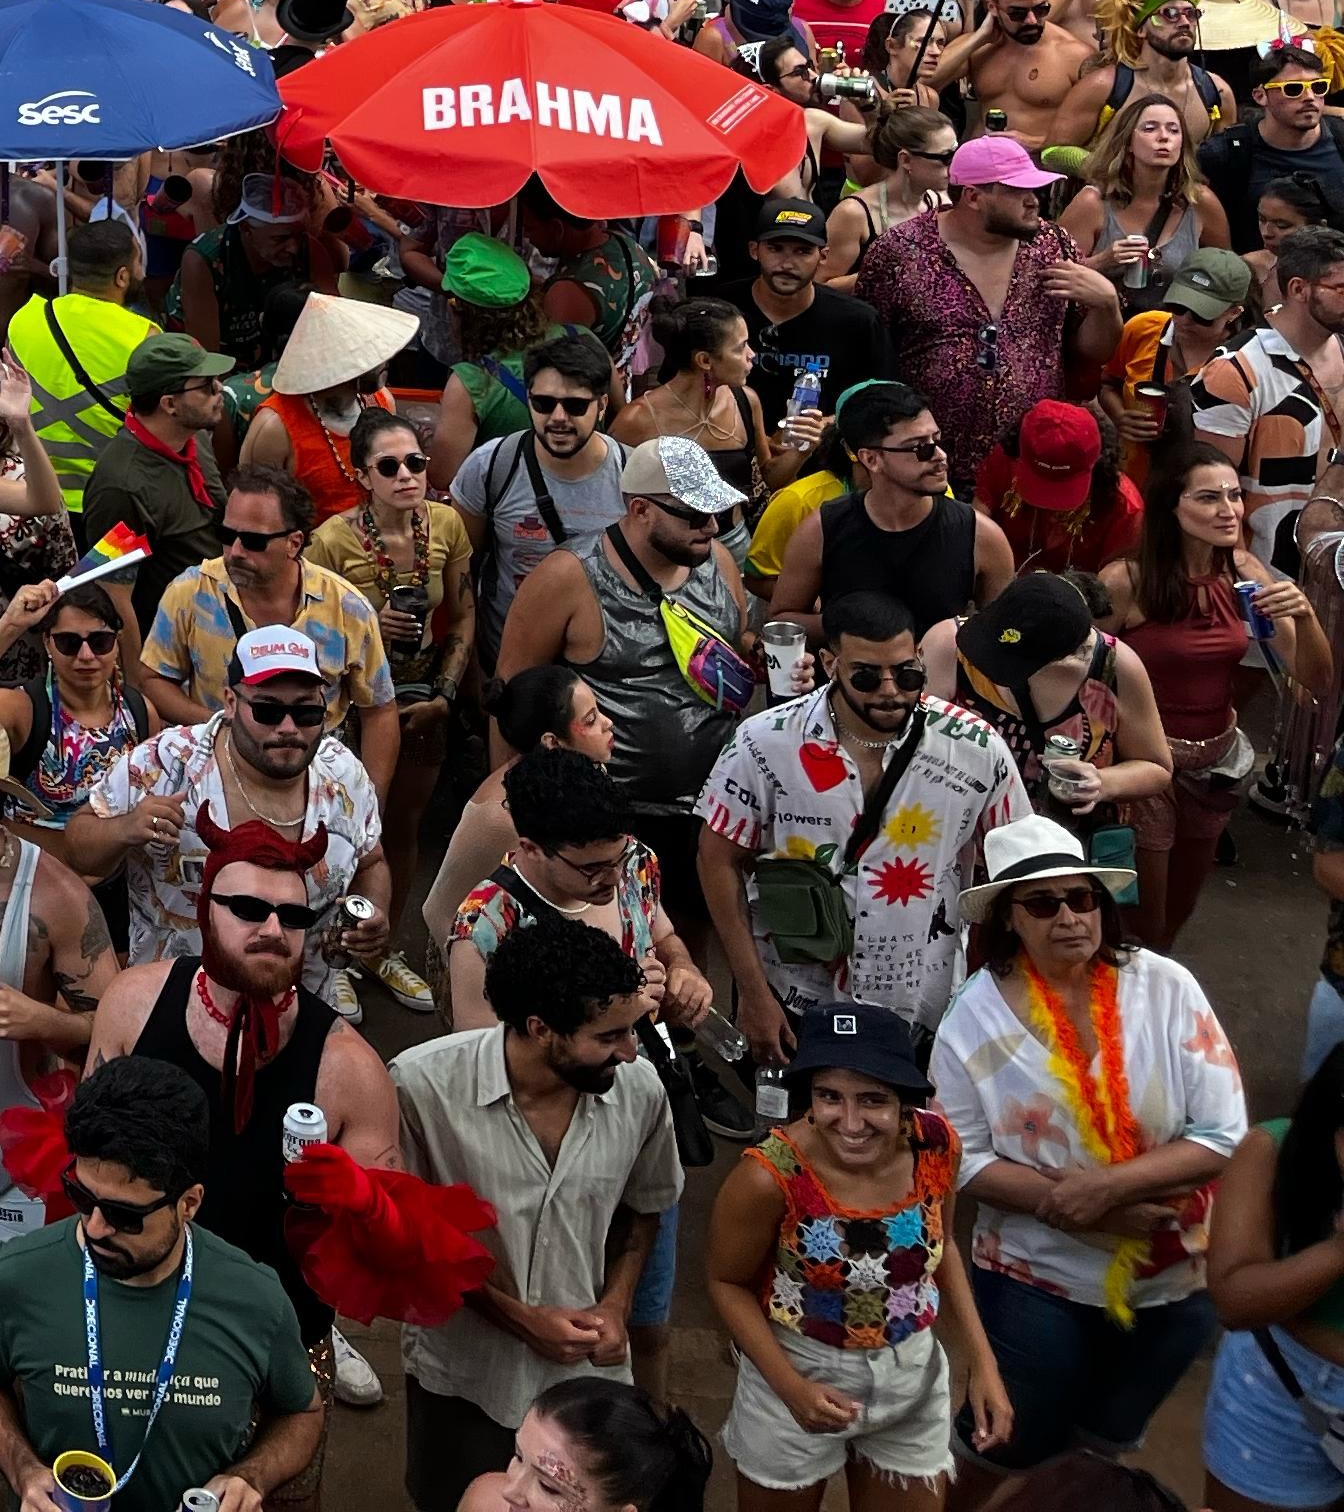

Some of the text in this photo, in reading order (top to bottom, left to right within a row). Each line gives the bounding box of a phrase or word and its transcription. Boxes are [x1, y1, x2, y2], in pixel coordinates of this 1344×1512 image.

[423, 78, 662, 146] BRAHMA
[113, 1370, 122, 1381] a
[194, 1376, 220, 1390] que
[126, 1389, 150, 1400] ver
[174, 1391, 221, 1406] mundo
